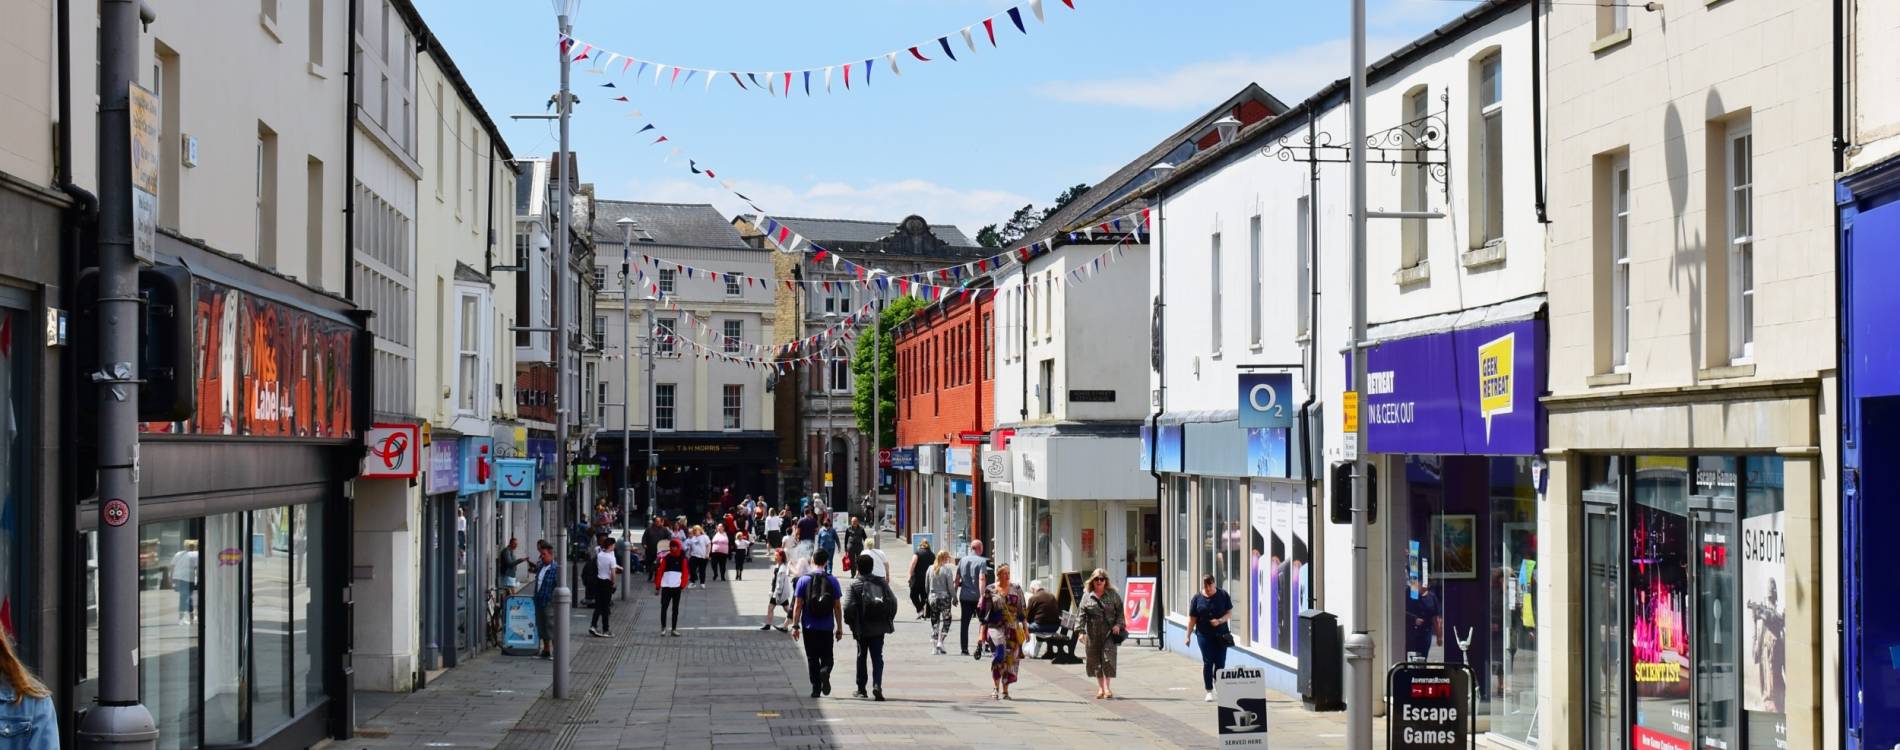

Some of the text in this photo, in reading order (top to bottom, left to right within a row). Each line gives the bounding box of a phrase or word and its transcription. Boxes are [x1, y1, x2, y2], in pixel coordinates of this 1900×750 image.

[1483, 356, 1498, 377] GEEK
[1367, 371, 1394, 395] RETREAT
[1483, 375, 1509, 398] RETREAT
[255, 379, 279, 421] Label
[1376, 404, 1382, 424] &
[1382, 403, 1400, 424] GEEK
[1401, 402, 1414, 423] OUT
[694, 445, 720, 453] MORRIS
[1696, 468, 1736, 489] Escape Games
[1745, 529, 1785, 564] SABOTA
[1221, 668, 1262, 680] LAVAZZA
[1635, 662, 1681, 682] SCIENTIST
[1402, 704, 1457, 724] Escape
[1403, 726, 1456, 744] Games
